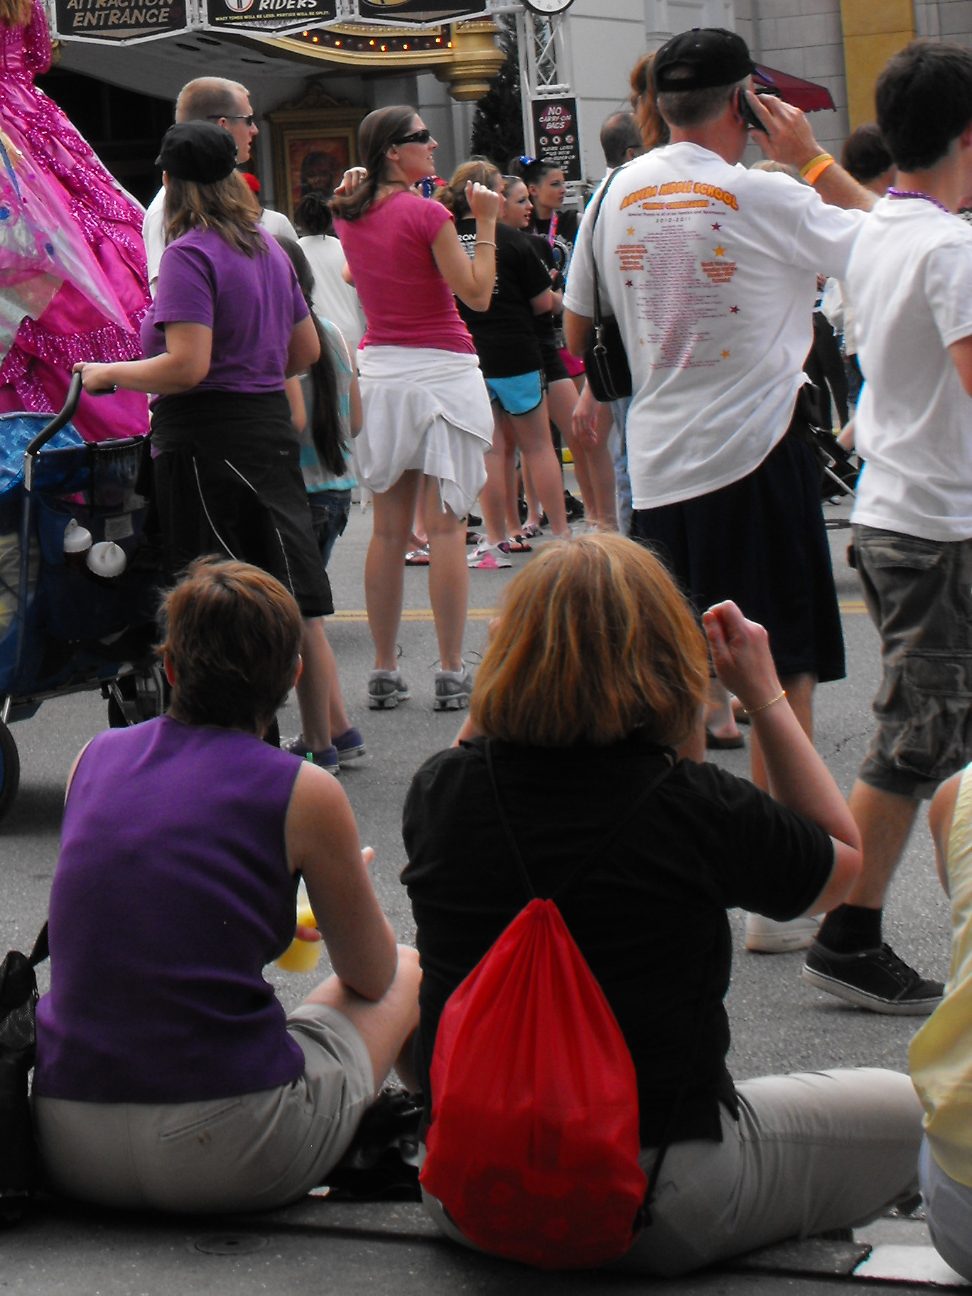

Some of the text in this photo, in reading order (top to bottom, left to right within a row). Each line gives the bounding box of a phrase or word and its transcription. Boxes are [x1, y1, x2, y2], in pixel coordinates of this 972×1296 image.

[73, 8, 170, 27] ENTRANCE
[548, 106, 562, 116] NO
[539, 114, 572, 123] CARRY-ON
[546, 122, 565, 130] BAGS
[659, 180, 693, 196] MIDDLE
[693, 182, 739, 211] SCHOOL
